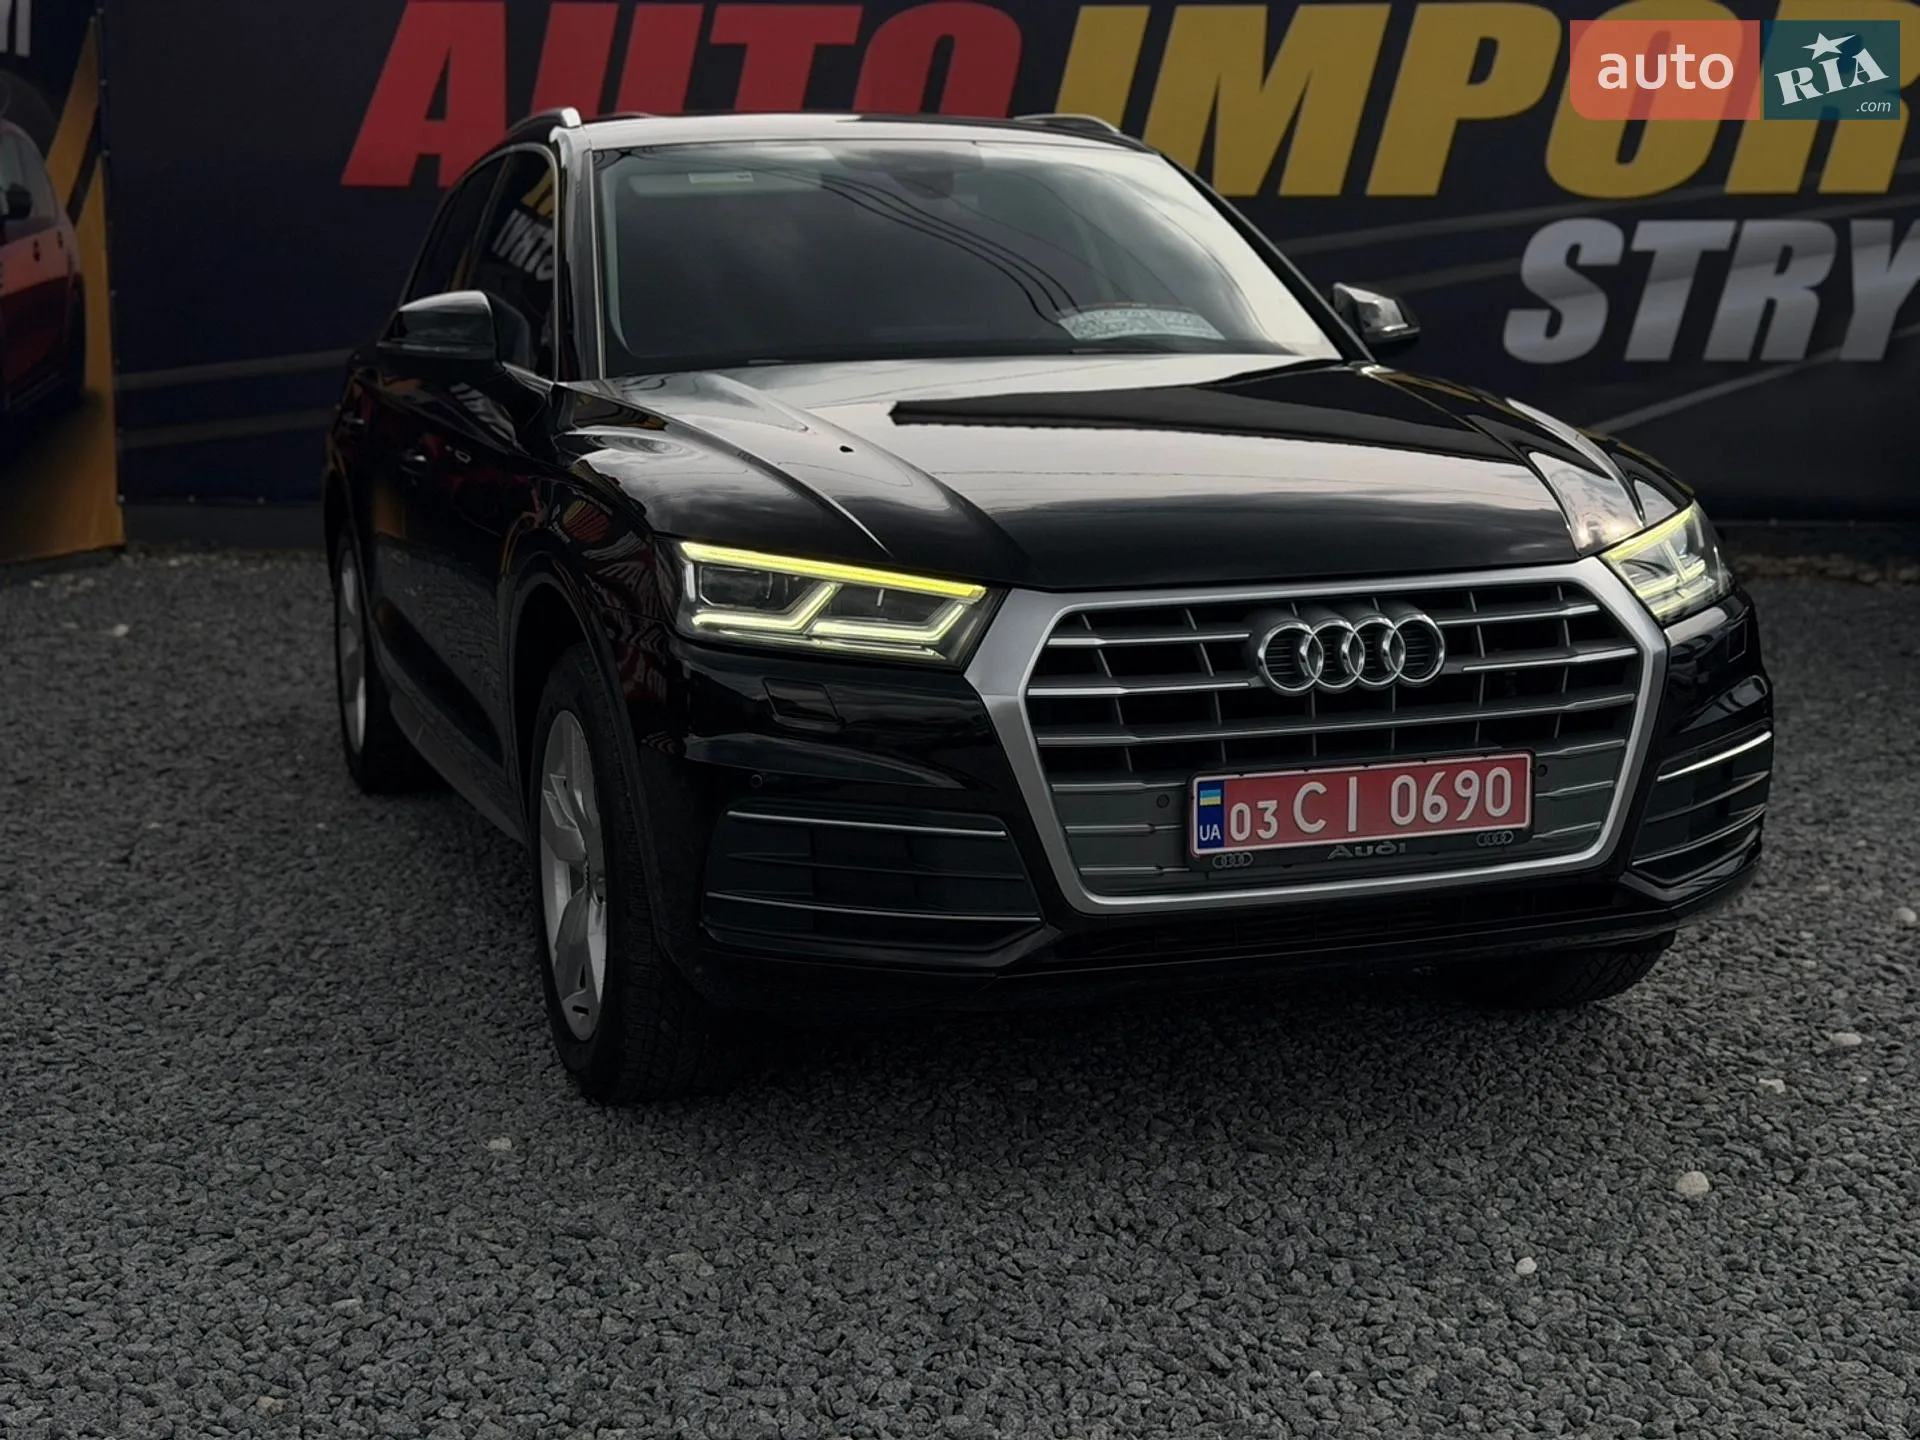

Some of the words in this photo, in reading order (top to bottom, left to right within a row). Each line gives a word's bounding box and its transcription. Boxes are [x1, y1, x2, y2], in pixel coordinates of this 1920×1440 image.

[340, 0, 1022, 187] AUTO
[1503, 218, 1920, 363] STRY
[1200, 824, 1221, 841] UA
[1230, 800, 1278, 841] 03
[1391, 766, 1511, 826] 0690
[1328, 841, 1406, 860] Audi
